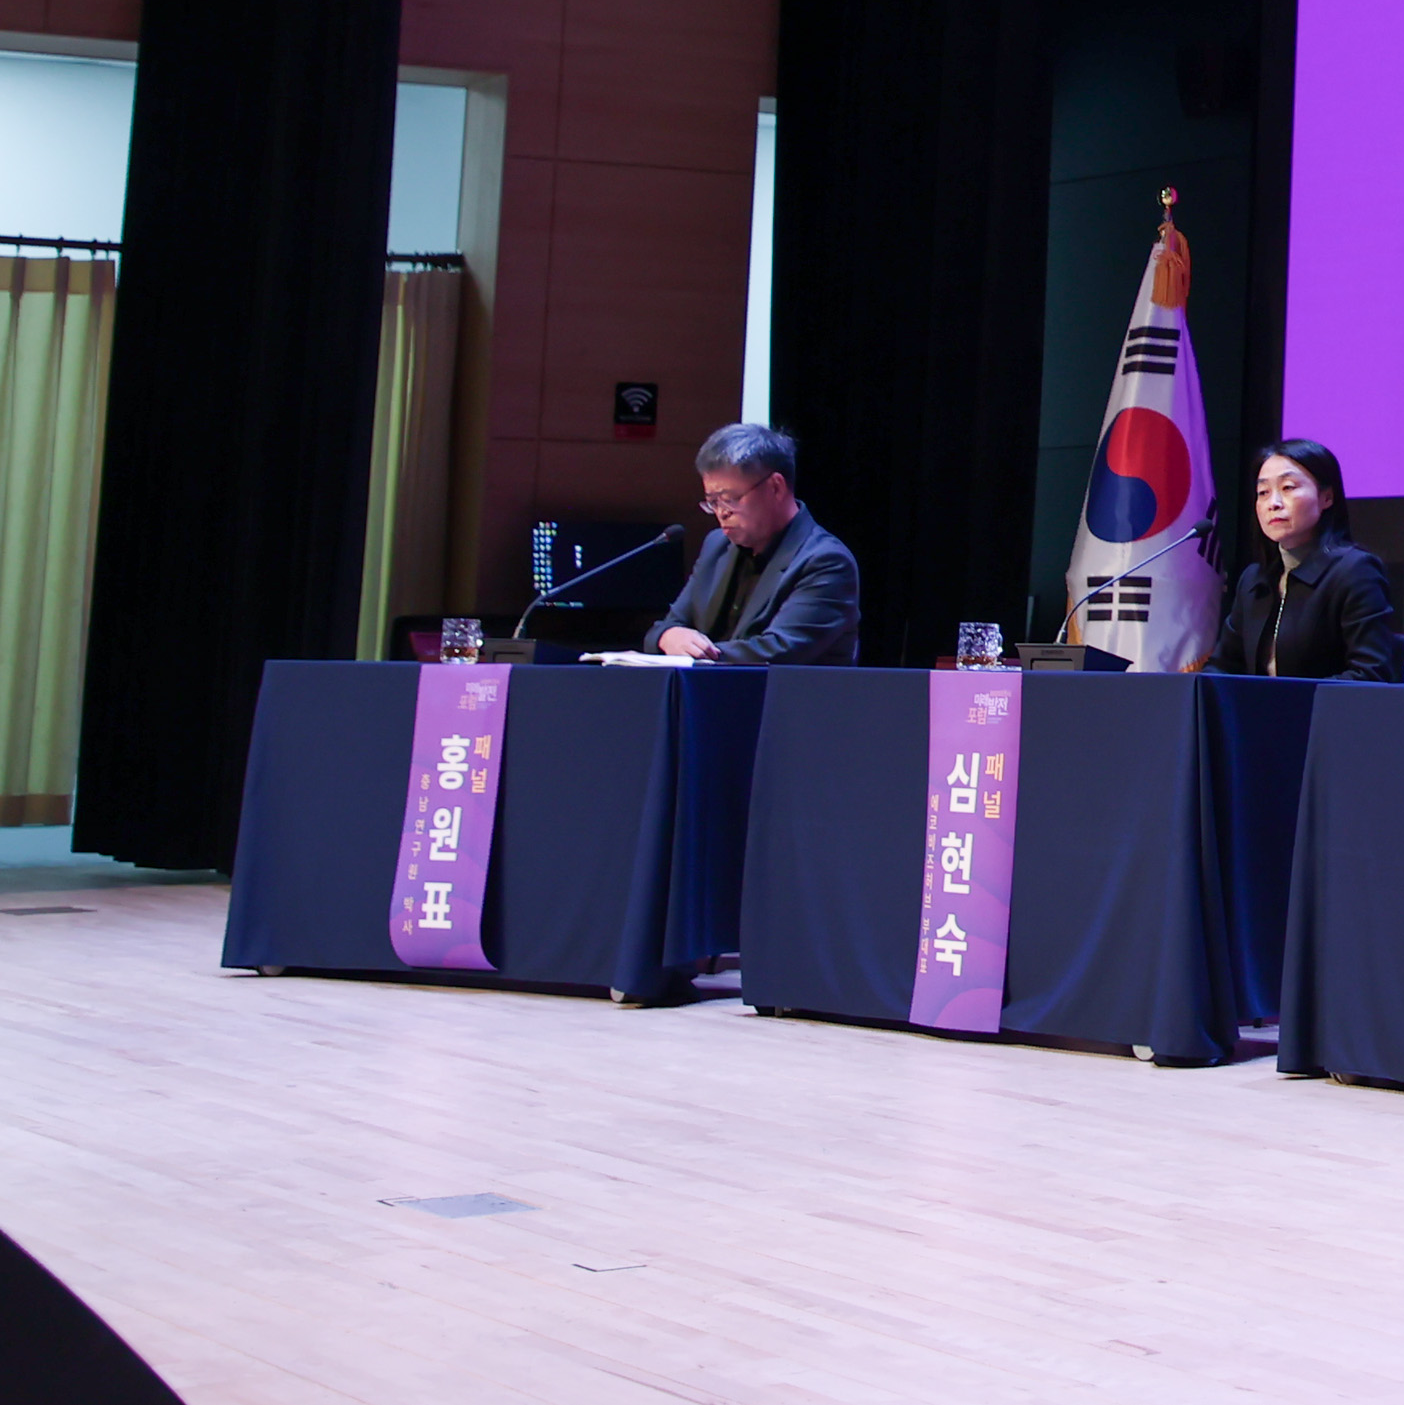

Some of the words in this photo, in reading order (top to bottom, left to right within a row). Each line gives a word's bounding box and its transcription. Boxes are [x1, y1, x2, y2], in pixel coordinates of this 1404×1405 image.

[471, 734, 492, 794] 패널
[983, 752, 1005, 819] 패널
[418, 734, 471, 930] 홍원표
[933, 751, 981, 978] 심현숙
